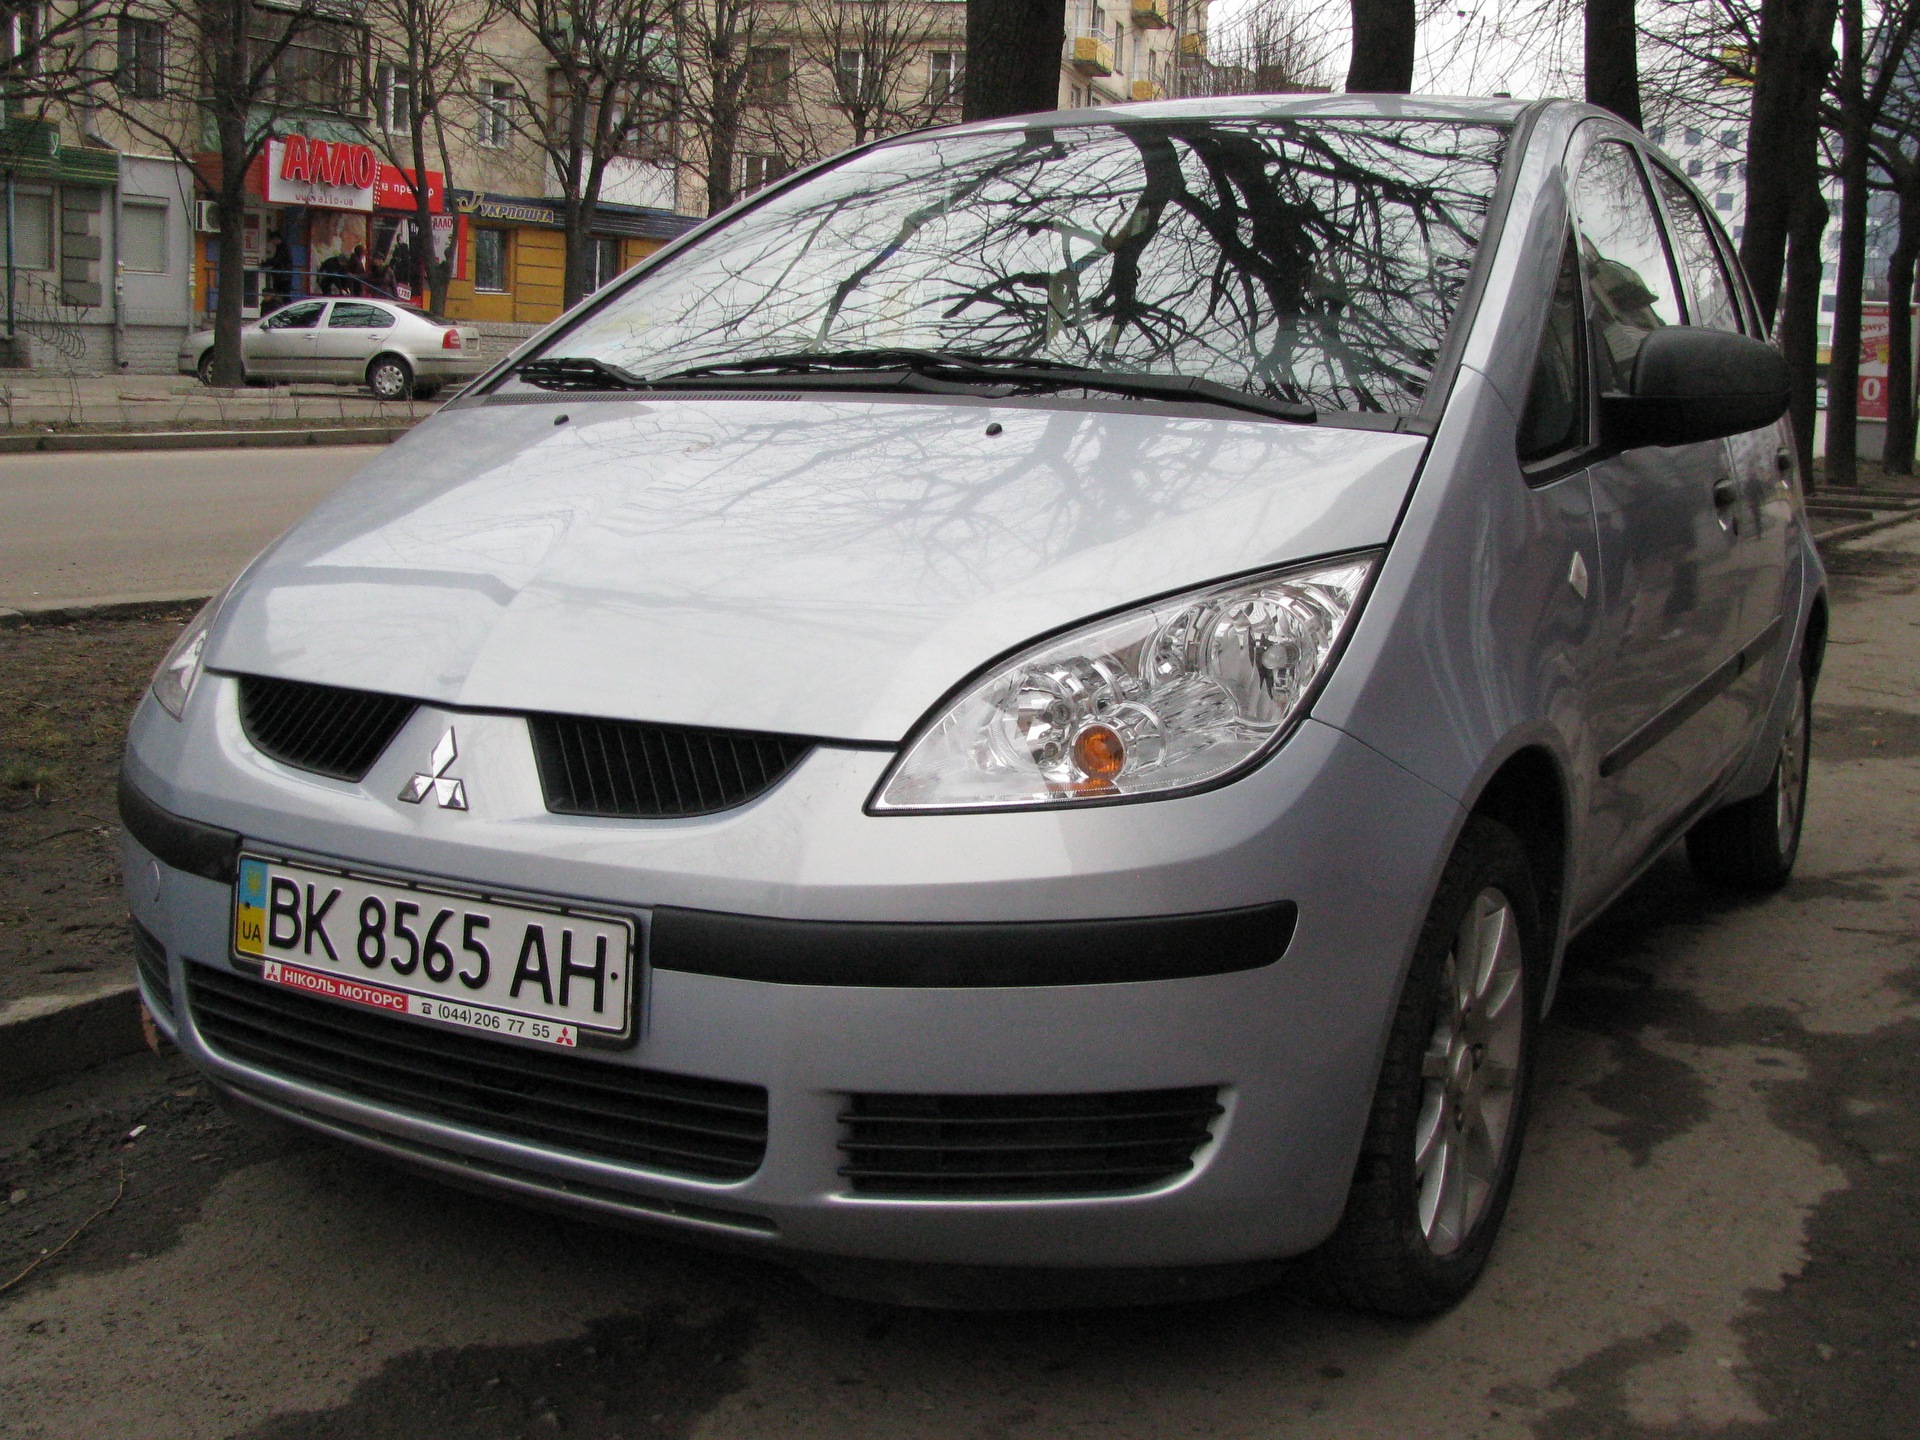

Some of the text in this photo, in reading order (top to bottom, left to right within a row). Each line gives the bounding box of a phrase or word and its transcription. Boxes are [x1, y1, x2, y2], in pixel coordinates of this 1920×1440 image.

[280, 134, 376, 190] АЛЛО
[480, 203, 554, 224] УКРПОШТА
[242, 922, 262, 943] UA
[357, 896, 491, 990] 8565
[284, 969, 404, 1009] НІКОЛЬ МОТОРС
[507, 1018, 525, 1033] 77
[532, 1023, 550, 1038] 55
